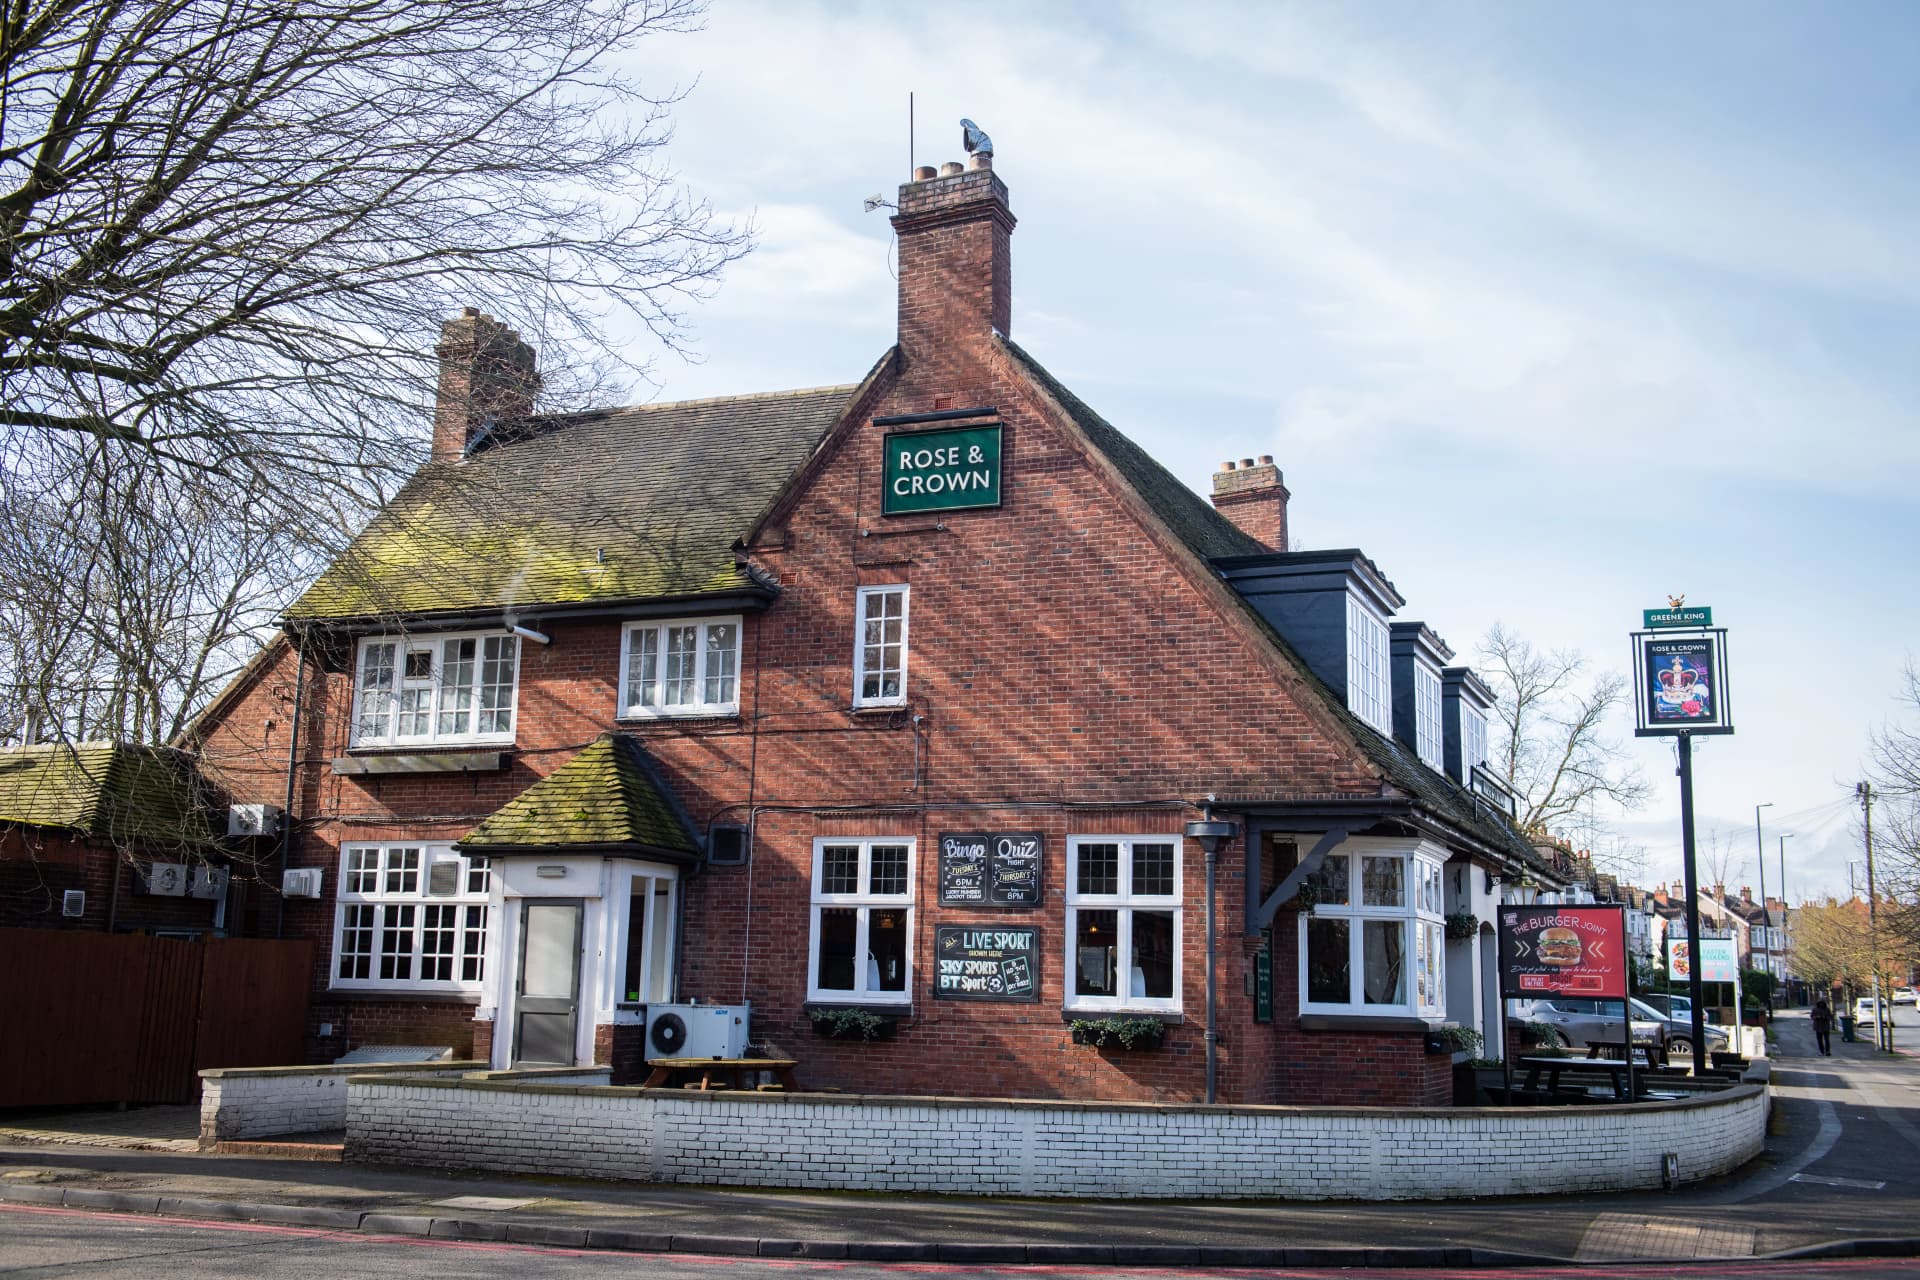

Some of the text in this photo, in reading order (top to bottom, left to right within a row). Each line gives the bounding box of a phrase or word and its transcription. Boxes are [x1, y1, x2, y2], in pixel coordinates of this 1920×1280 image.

[899, 445, 984, 470] ROSE &
[894, 470, 990, 495] CROWN
[1651, 613, 1682, 621] GREENE
[1678, 644, 1706, 652] CROWN
[944, 839, 985, 862] Bingo
[1512, 922, 1529, 936] THE
[1529, 915, 1580, 929] BURGER
[1580, 921, 1608, 936] JOINT
[945, 937, 958, 949] ALL
[963, 932, 1033, 950] LIVE SPORT
[940, 959, 964, 974] SKY
[965, 960, 999, 975] SPORTS
[940, 975, 988, 992] BT Sport
